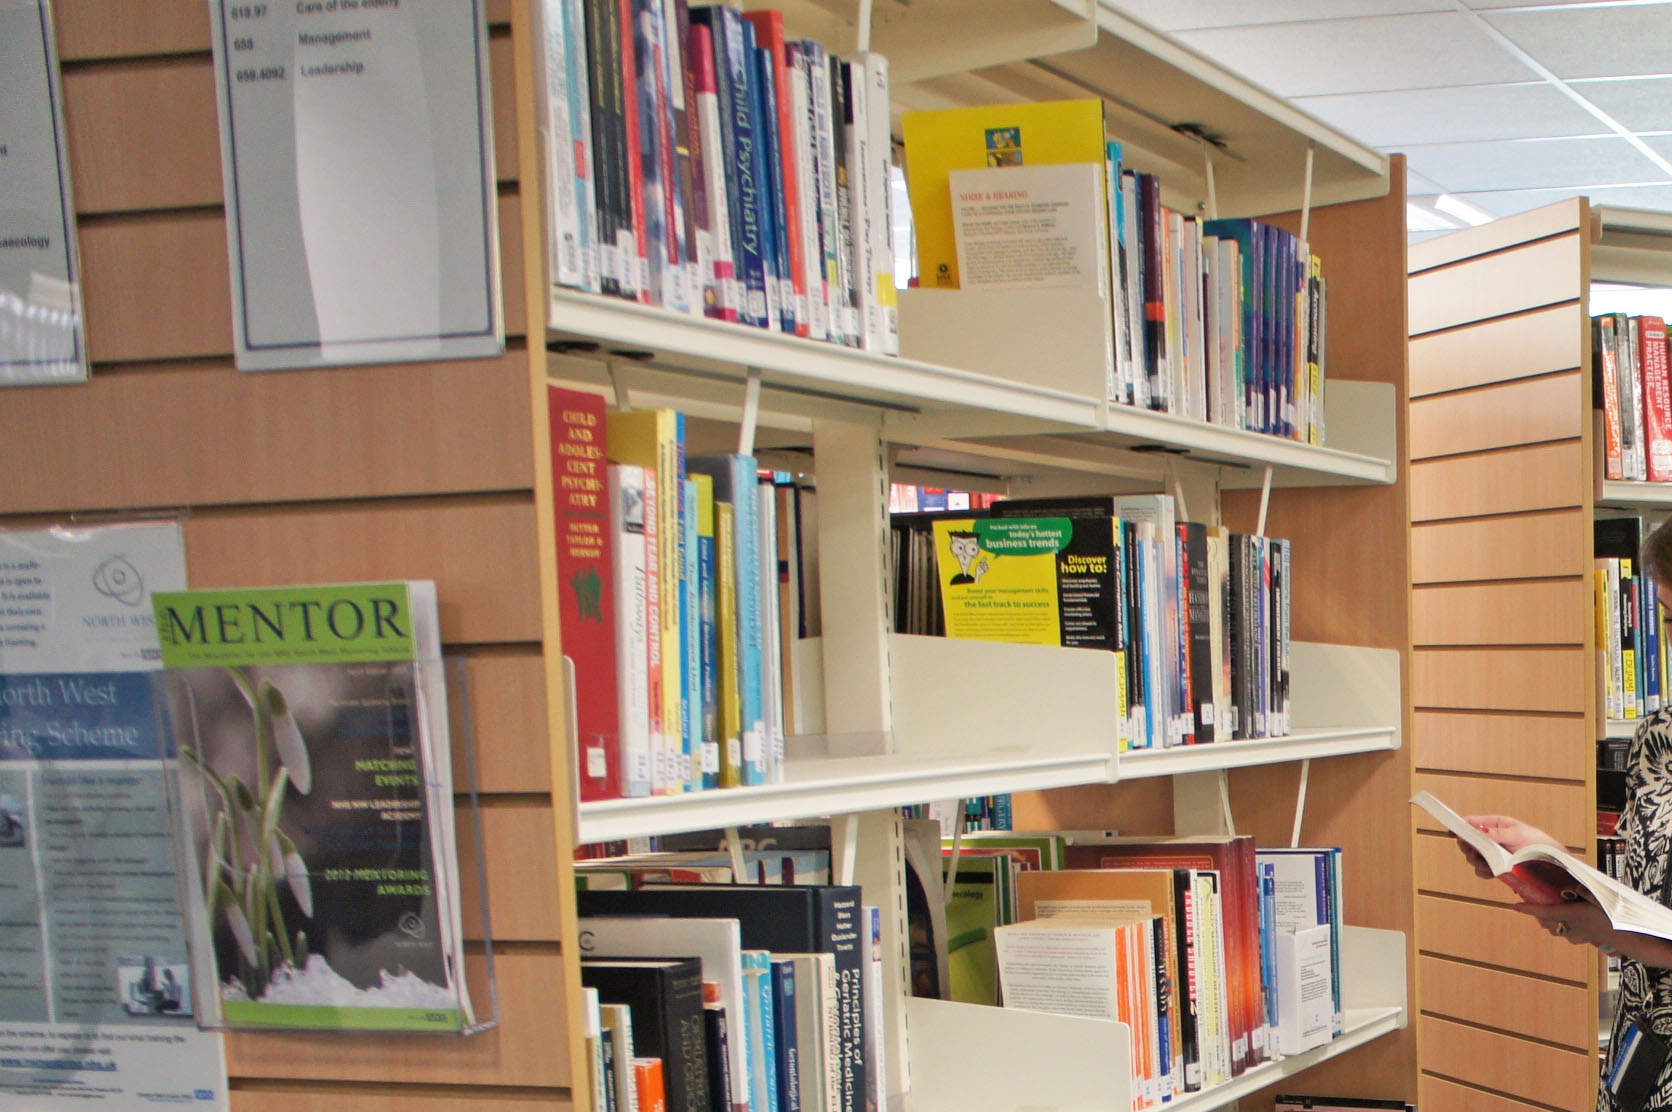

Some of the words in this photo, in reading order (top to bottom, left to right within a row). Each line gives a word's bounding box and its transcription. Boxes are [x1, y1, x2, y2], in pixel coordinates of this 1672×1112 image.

[296, 1, 323, 15] Care
[326, 1, 337, 12] of
[298, 29, 372, 46] Management
[300, 61, 364, 78] Leadership
[731, 64, 752, 127] Child
[737, 136, 760, 257] Psychiatry
[992, 190, 1029, 200] HEARING
[1311, 289, 1320, 355] Accounting
[1645, 341, 1655, 388] PRACTICE
[1659, 342, 1668, 378] HUMAN
[1652, 342, 1662, 409] MANAGEMENT
[562, 409, 598, 427] CHILD
[1663, 379, 1672, 430] RESOURCE
[568, 427, 593, 442] AND
[566, 459, 597, 475] CENT
[646, 480, 657, 537] BEYOND
[985, 538, 1027, 549] business
[1029, 538, 1060, 548] trends
[1008, 529, 1035, 539] today's
[1036, 529, 1062, 538] hottest
[648, 538, 658, 569] FEAR
[1061, 562, 1087, 573] how
[1089, 563, 1108, 573] to:
[1067, 554, 1107, 565] Discover
[649, 572, 659, 601] AND
[1115, 573, 1123, 622] Complete
[993, 600, 1013, 608] track
[1023, 601, 1050, 609] success
[130, 615, 157, 626] WES
[166, 598, 409, 646] MENTOR
[650, 604, 661, 667] CONTROL
[1116, 624, 1125, 650] MBA
[0, 677, 52, 706] orth
[59, 677, 118, 707] West
[377, 884, 431, 896] AWARDS
[1158, 965, 1168, 1013] HANDY
[841, 970, 853, 1041] Geriatric
[850, 968, 861, 1046] Principles
[680, 1020, 692, 1059] AND
[691, 1015, 706, 1107] GERIATRIC
[853, 1048, 862, 1066] of
[788, 1048, 799, 1111] Gerontological
